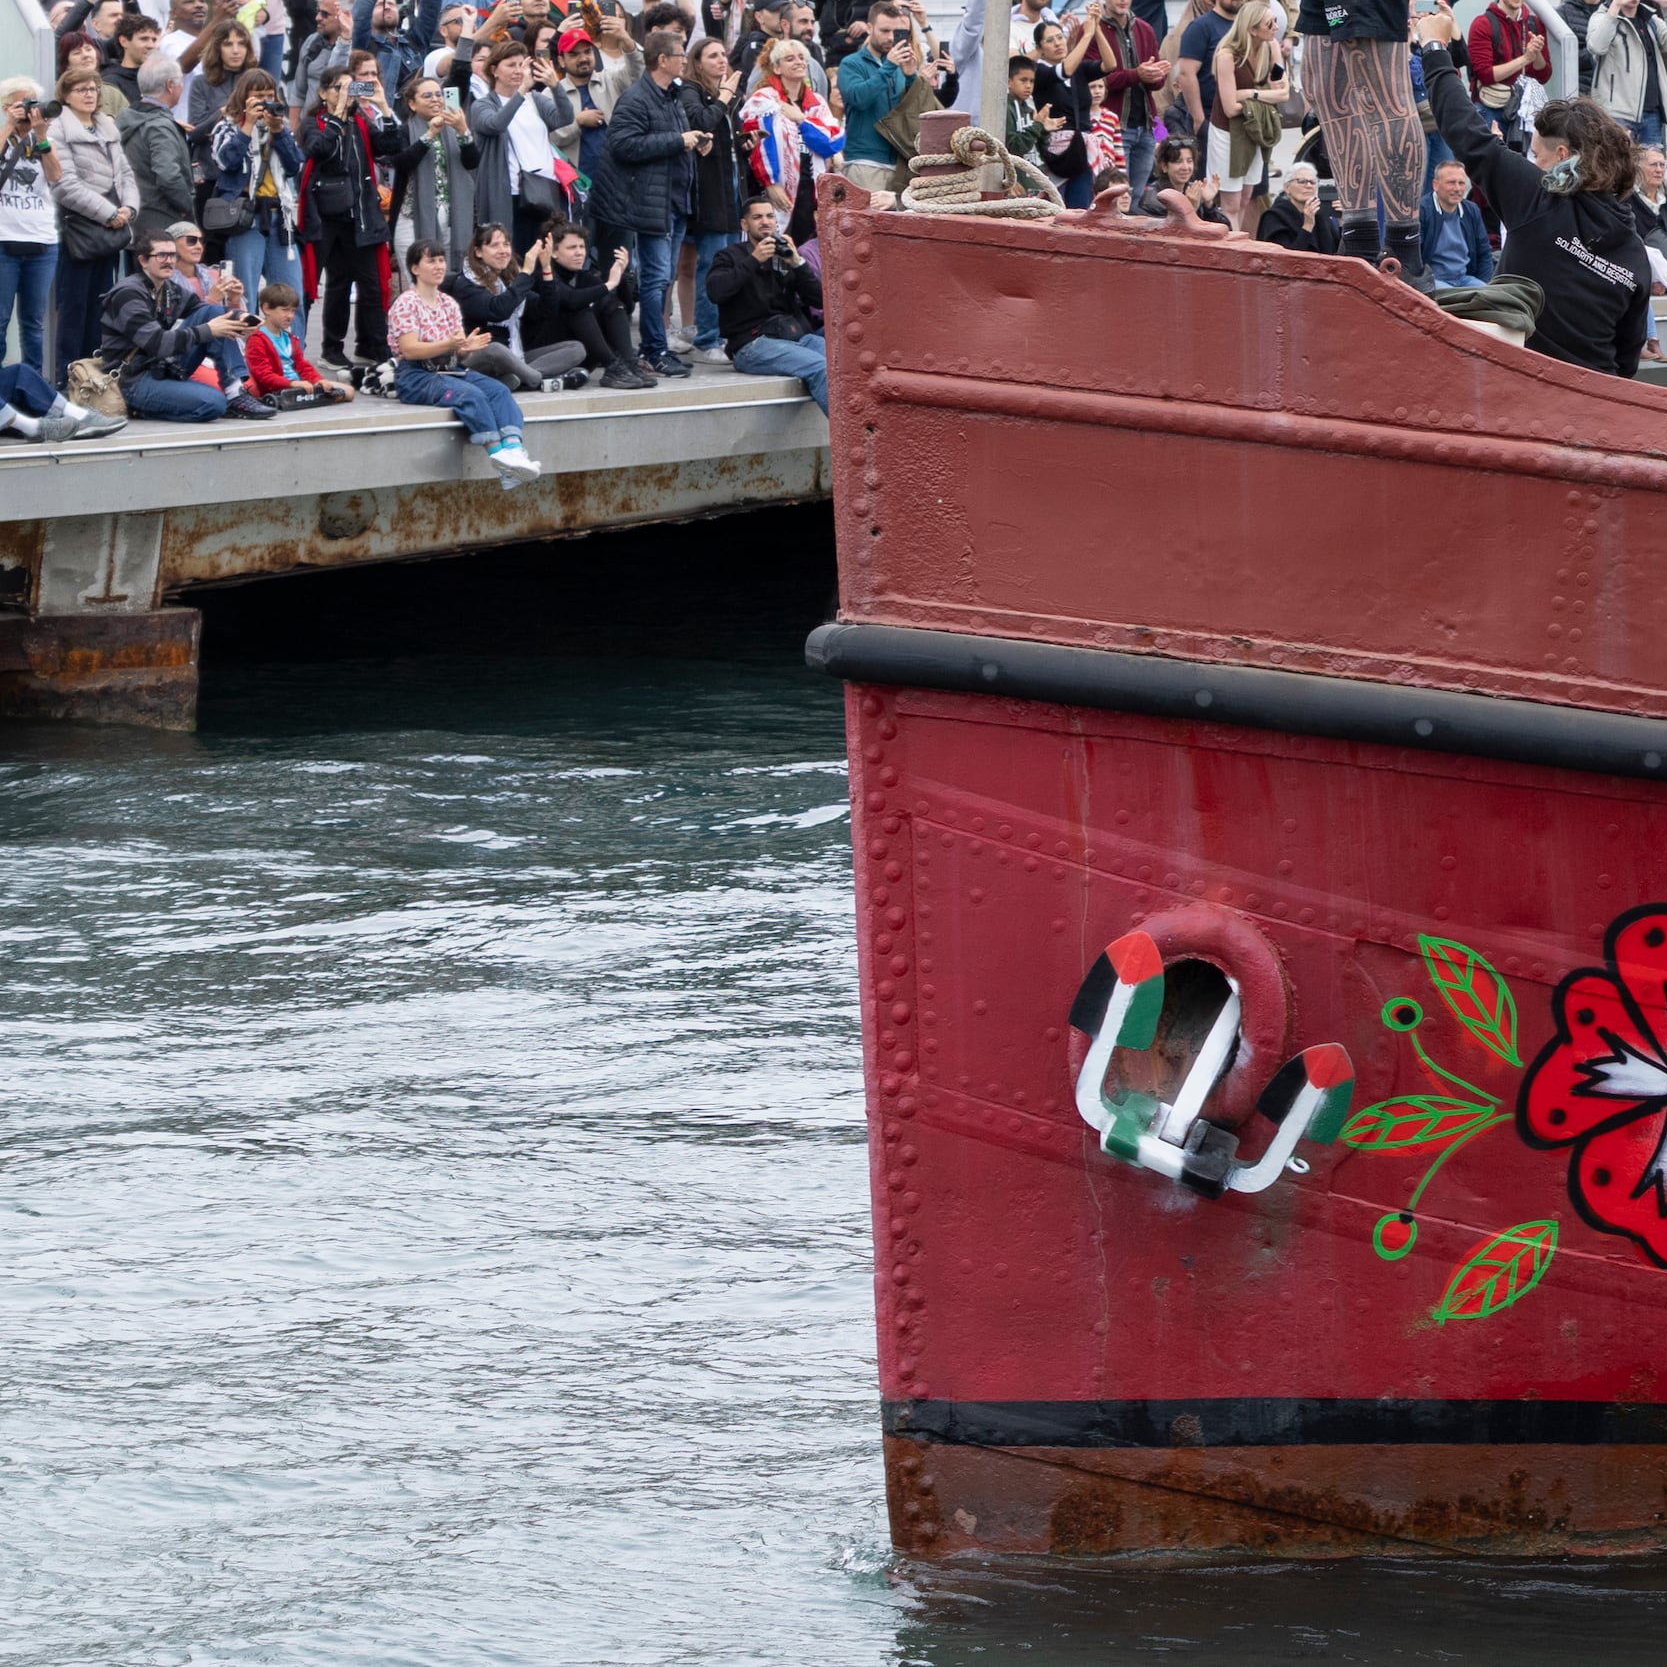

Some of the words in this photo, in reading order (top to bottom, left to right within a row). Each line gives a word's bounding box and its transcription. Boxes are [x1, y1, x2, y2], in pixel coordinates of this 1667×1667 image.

[1555, 237, 1595, 264] SOLIDARITY
[1592, 260, 1607, 273] AND
[1606, 267, 1638, 292] RESISTANC
